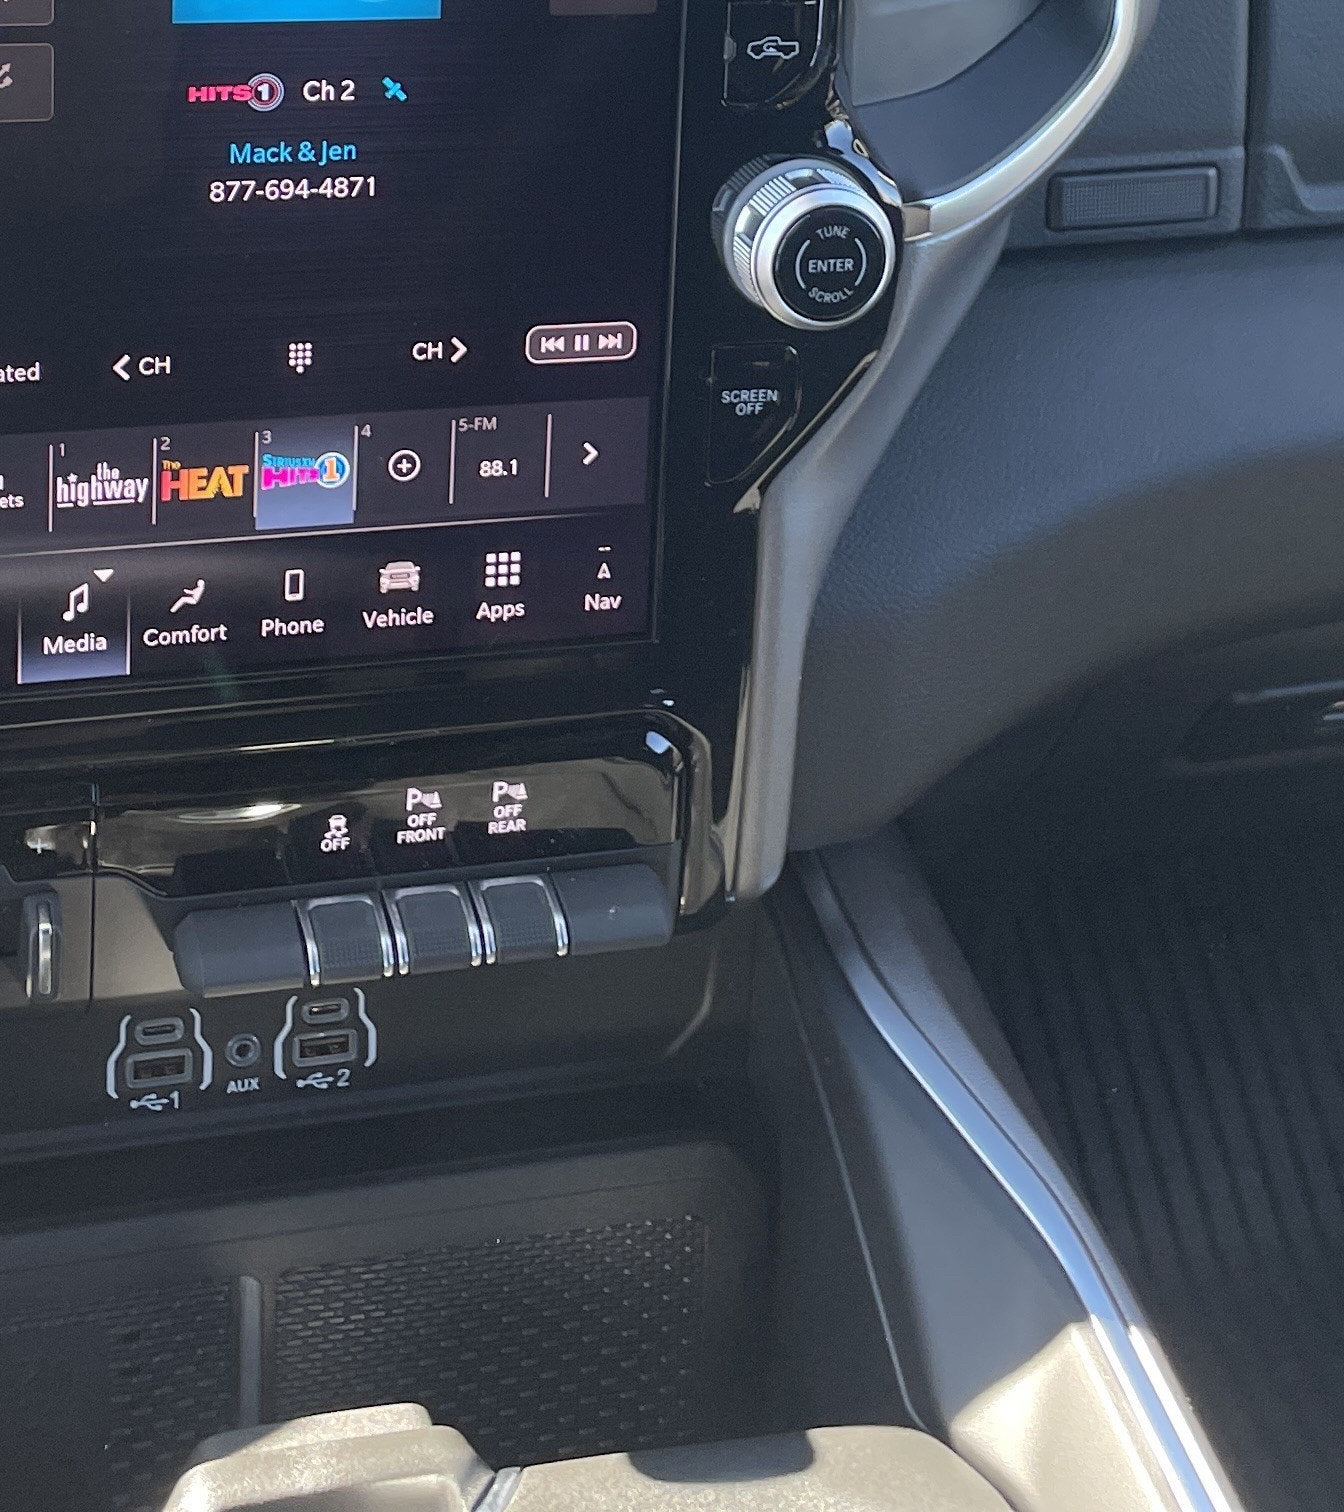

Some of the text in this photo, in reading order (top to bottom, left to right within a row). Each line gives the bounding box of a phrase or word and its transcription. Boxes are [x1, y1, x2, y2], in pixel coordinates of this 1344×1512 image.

[303, 79, 356, 102] Ch 2
[229, 140, 357, 167] Mack & Jen
[209, 175, 376, 203] 877-694-4871
[815, 224, 850, 241] TUNE
[808, 257, 855, 274] ENTER
[807, 286, 854, 304] SCROLL
[411, 340, 444, 361] CH
[138, 355, 172, 376] CH
[720, 388, 778, 404] SCREEN
[734, 401, 764, 417] OFF
[360, 423, 372, 438] 4
[458, 416, 497, 433] 5-FM
[159, 436, 171, 451] 2
[261, 430, 272, 445] 3
[58, 442, 66, 458] 1
[96, 461, 120, 481] the
[479, 458, 519, 478] 88.1
[56, 475, 149, 508] highway
[160, 464, 250, 503] HEAT
[584, 592, 622, 611] Nav
[362, 606, 435, 629] Vehicle
[474, 600, 526, 623] Apps
[142, 623, 228, 647] Comfort
[260, 617, 325, 637] Phone
[42, 632, 108, 656] Media
[406, 811, 437, 828] OFF
[492, 803, 523, 819] OFF
[396, 826, 446, 845] FRONT
[487, 818, 527, 835] REAR
[319, 837, 350, 853] OFF
[226, 1076, 260, 1094] AUX
[336, 1068, 351, 1088] 2
[169, 1089, 180, 1110] 1
